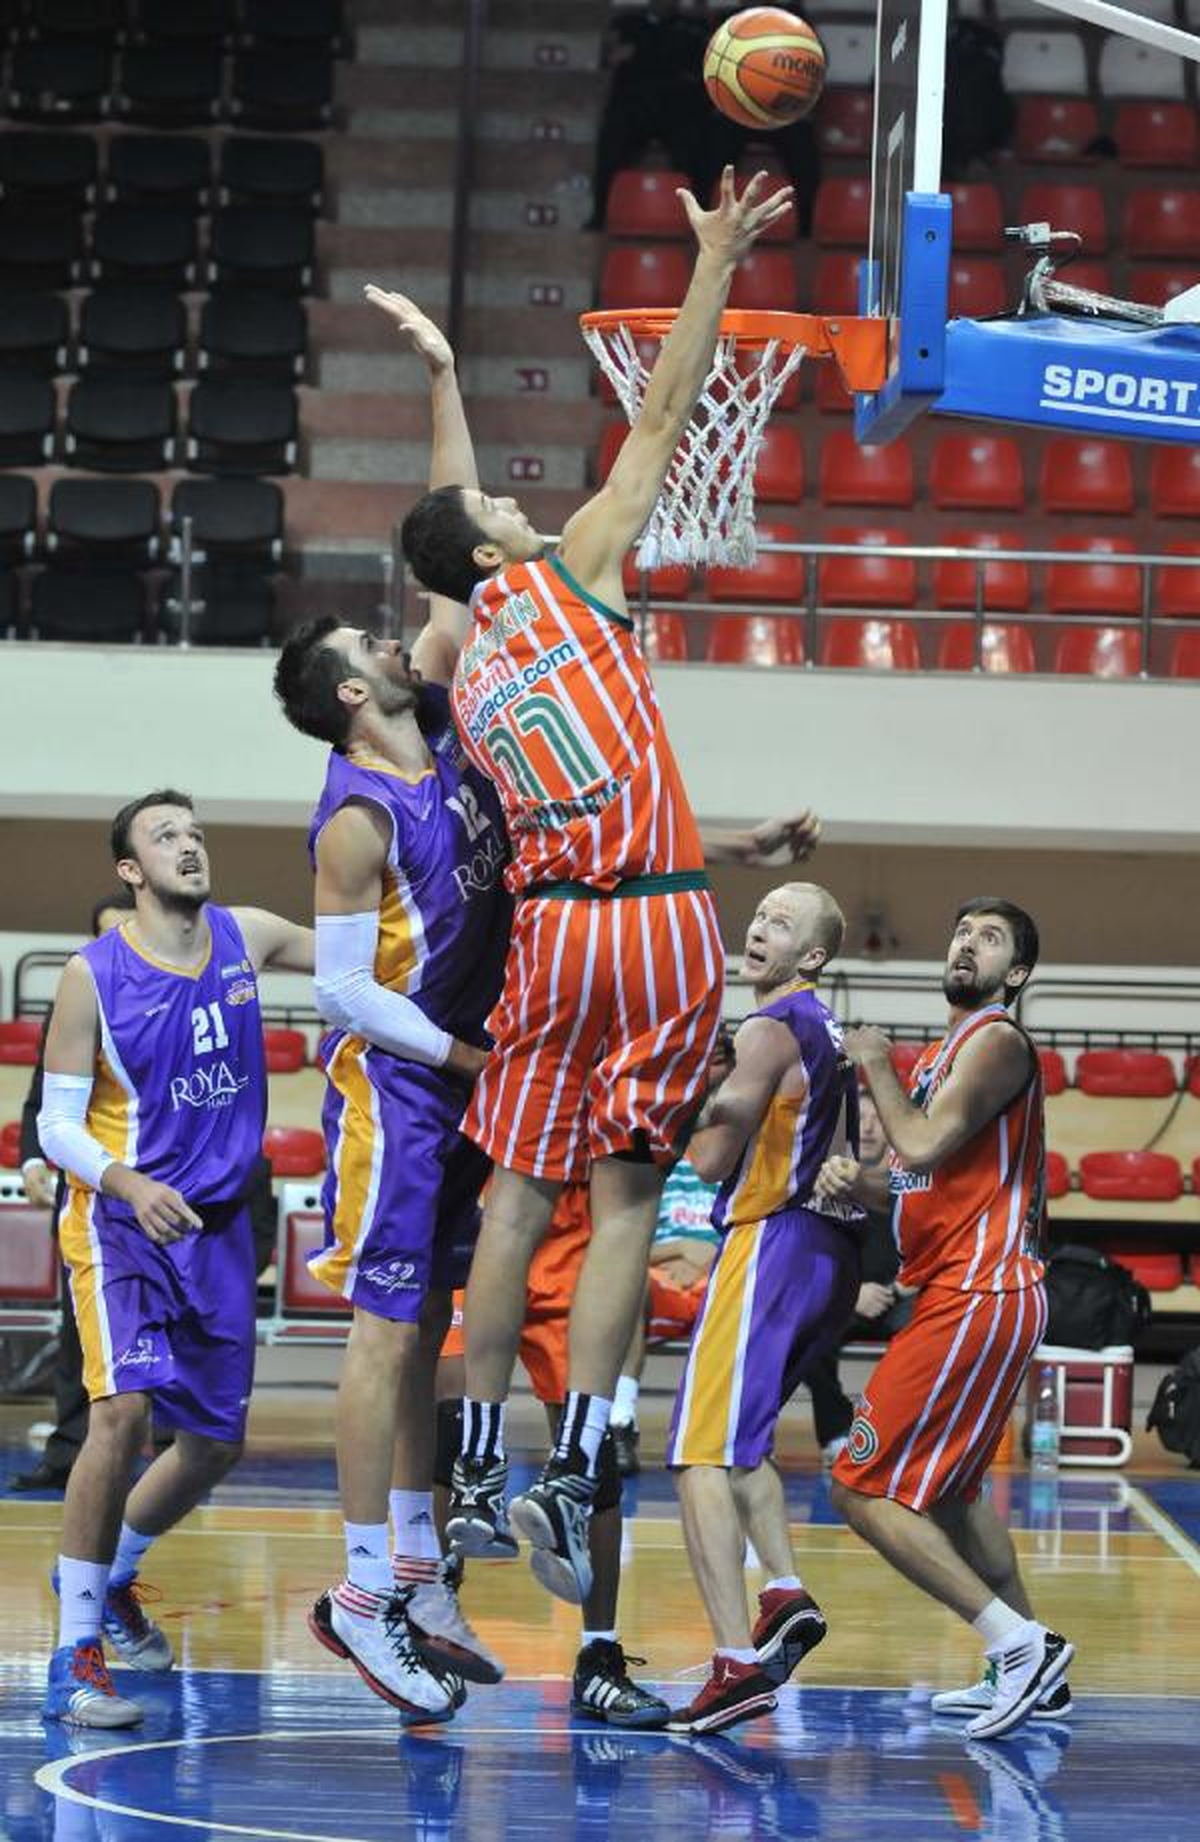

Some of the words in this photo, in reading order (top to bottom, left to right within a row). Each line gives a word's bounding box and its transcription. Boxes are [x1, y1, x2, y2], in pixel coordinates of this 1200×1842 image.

[1043, 364, 1200, 413] SPORT
[468, 642, 575, 744] burada.com
[445, 783, 492, 844] 12
[191, 1001, 229, 1056] 21
